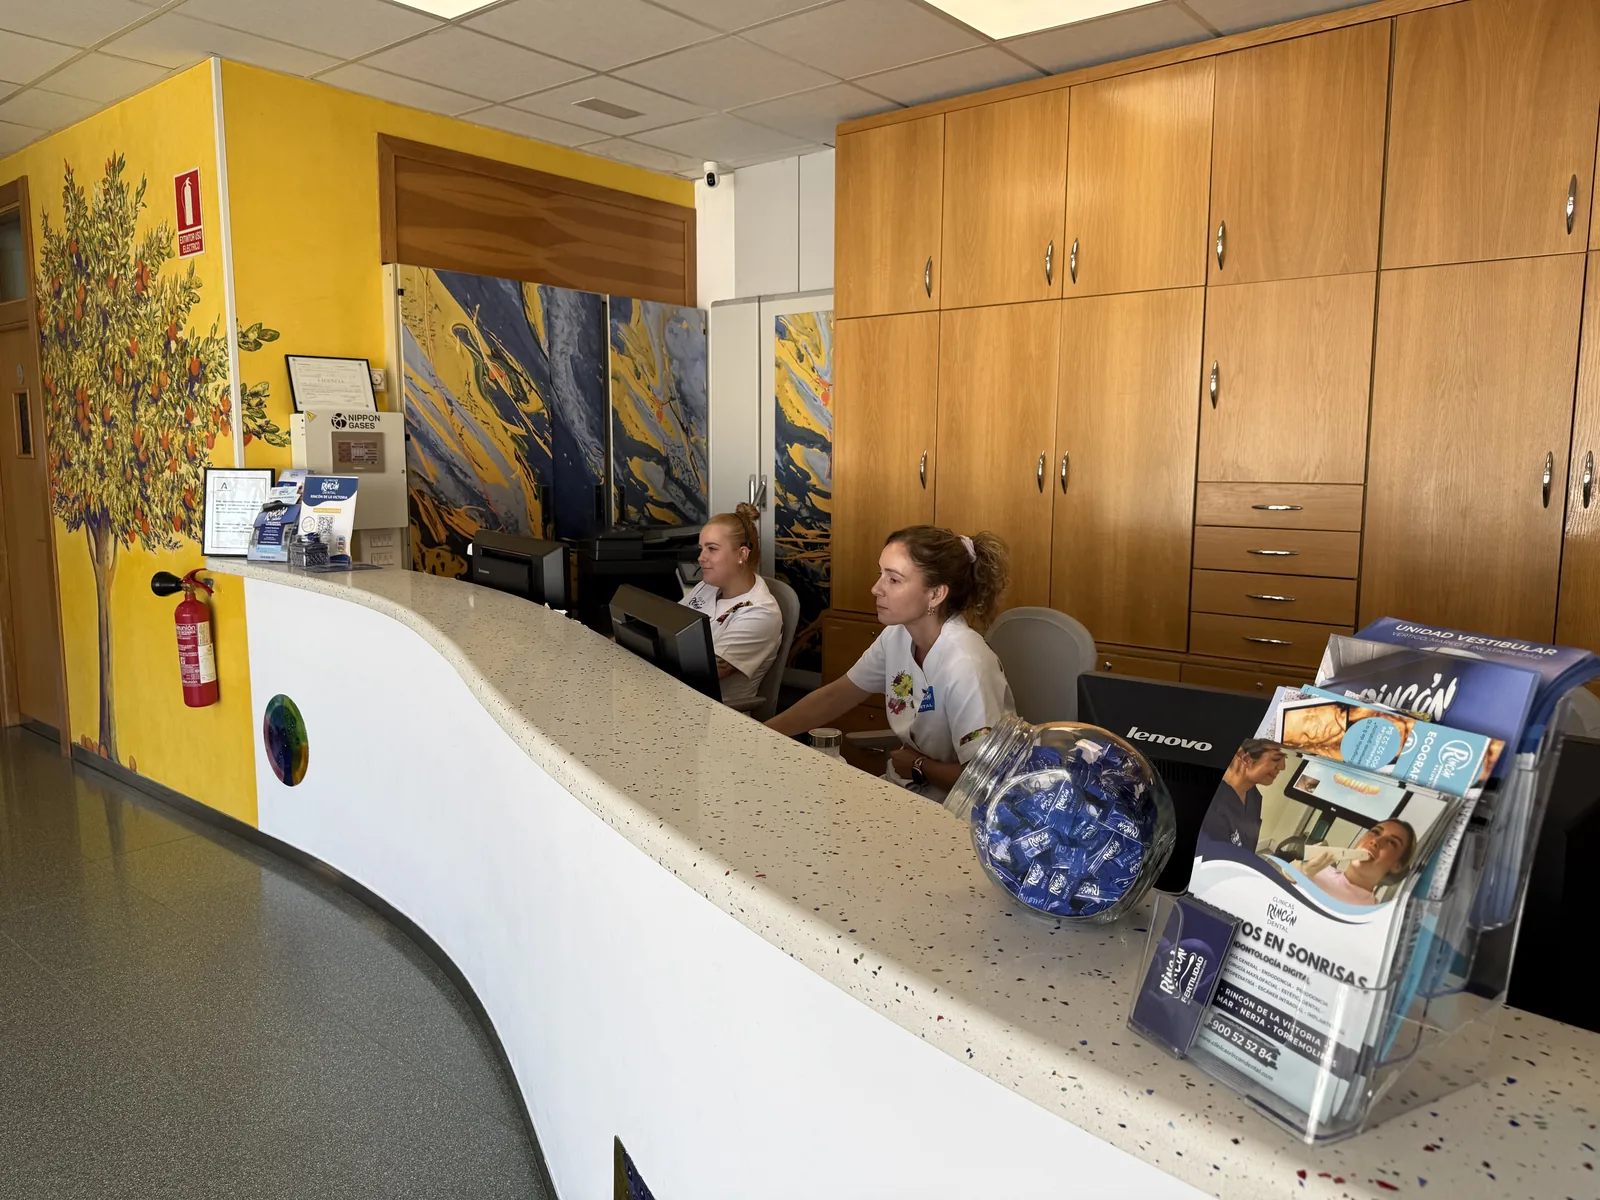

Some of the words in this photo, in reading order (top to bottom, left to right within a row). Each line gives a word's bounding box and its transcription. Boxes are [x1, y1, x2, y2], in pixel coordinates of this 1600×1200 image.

[1395, 624, 1454, 639] UNIDAD
[1457, 634, 1558, 656] VESTIBULAR
[1126, 726, 1212, 751] lenovo
[1376, 744, 1385, 755] 52
[1380, 734, 1389, 745] 52
[1370, 754, 1380, 769] 900
[1266, 918, 1289, 933] DENTAL
[1232, 939, 1282, 969] DONTOLOGÍA
[1261, 931, 1286, 952] EN
[1285, 941, 1370, 993] SONRISAS
[1181, 956, 1204, 1004] FERTILIDAD
[1238, 957, 1258, 970] GENERAL
[1295, 987, 1329, 1006] PEIODONCIA
[1215, 994, 1234, 1008] MAR
[1239, 1007, 1266, 1026] NERJA
[1224, 988, 1255, 1009] RINCÓN
[1255, 1005, 1268, 1016] DE
[1268, 1012, 1281, 1023] LA
[1280, 1018, 1322, 1046] VITORIA
[1210, 1020, 1232, 1037] 900
[1230, 1032, 1245, 1045] 52
[1244, 1039, 1258, 1053] 52
[1257, 1047, 1273, 1062] 84
